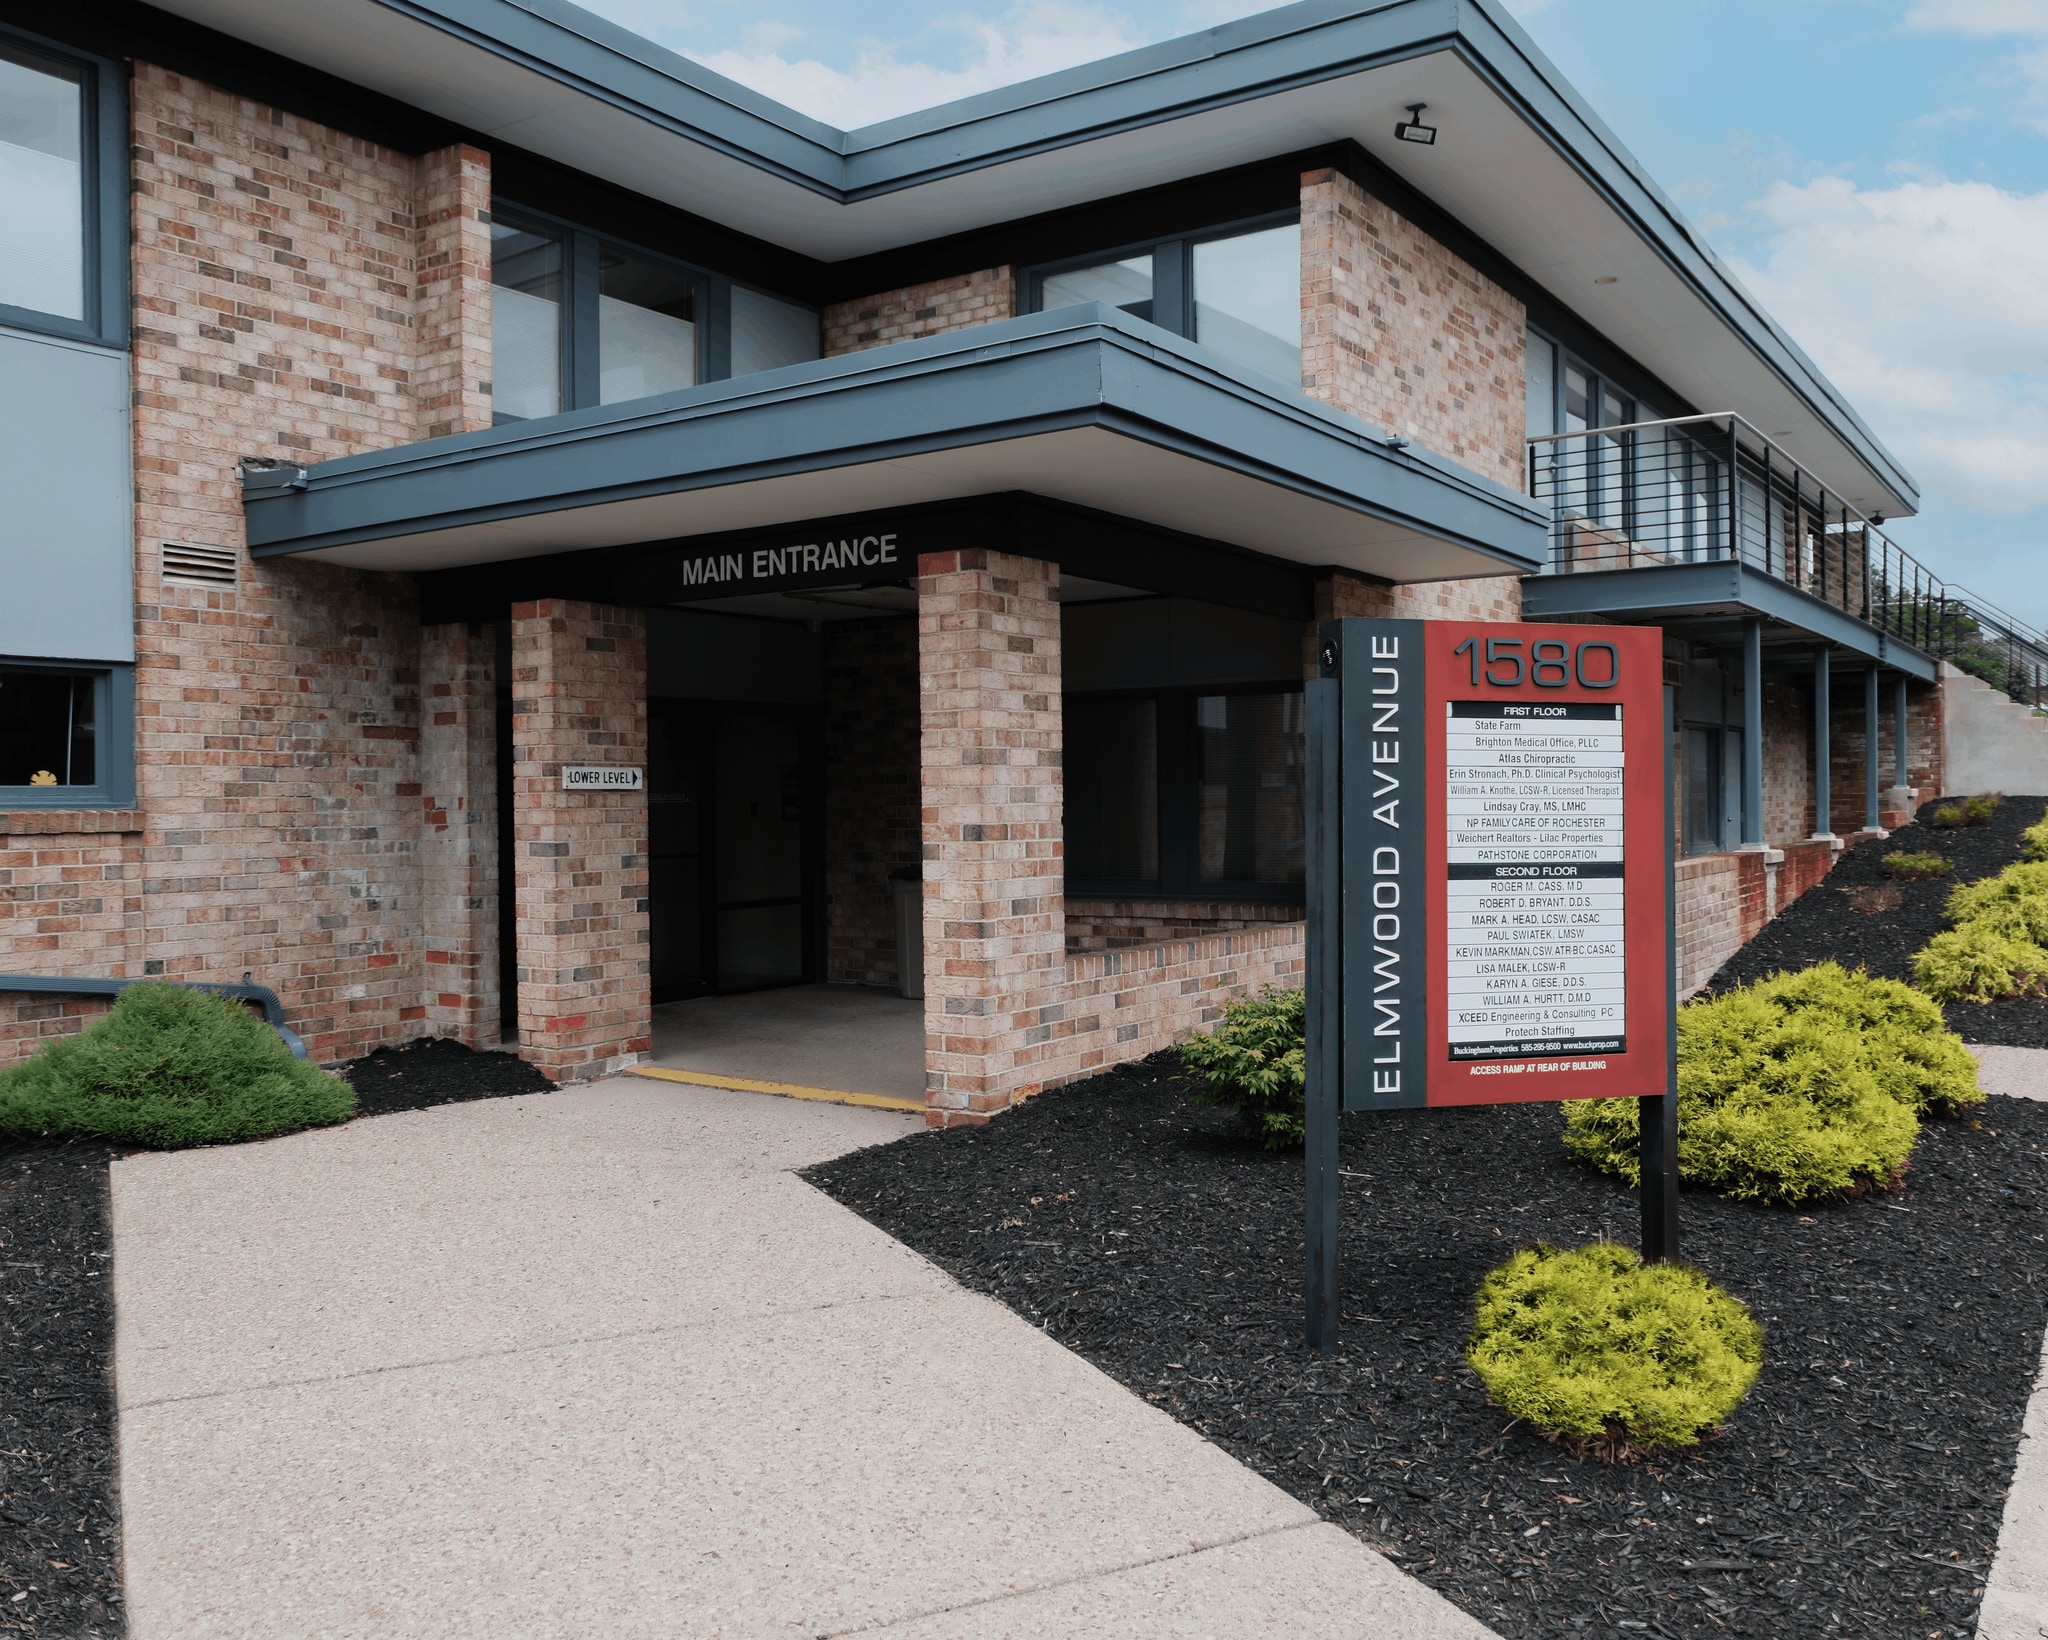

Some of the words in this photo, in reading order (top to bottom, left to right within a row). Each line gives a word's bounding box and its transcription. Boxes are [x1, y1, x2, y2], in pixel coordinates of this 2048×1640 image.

[683, 553, 743, 586] MAIN
[753, 534, 898, 578] ENTRANCE
[1455, 637, 1620, 688] 1580
[1504, 707, 1530, 716] FIRST
[1534, 707, 1567, 716] FLOOR
[1475, 721, 1496, 730] State
[1500, 721, 1521, 730] Farm
[1372, 636, 1400, 829] AVENUE
[1475, 737, 1512, 748] Brighton
[1515, 738, 1547, 747] Medical
[1550, 738, 1576, 748] Office,
[1578, 739, 1598, 747] PLLC
[1499, 754, 1521, 763] Atlas
[1524, 754, 1576, 765] Chiropractic
[569, 771, 600, 783] LOWER
[603, 772, 630, 784] LEVEL
[1450, 769, 1466, 778] Erin
[1469, 770, 1509, 779] Stronach,
[1512, 770, 1533, 778] Ph.D.
[1535, 769, 1566, 778] Clinical
[1569, 770, 1620, 780] Psychologist
[1451, 786, 1478, 795] William
[1481, 786, 1487, 795] A.
[1490, 786, 1517, 795] Knothe,
[1519, 786, 1550, 795] LCSW-R,
[1553, 786, 1583, 795] Licensed
[1586, 786, 1619, 797] Therapist
[1484, 802, 1517, 813] Lindsay
[1520, 802, 1541, 812] Cray,
[1544, 802, 1559, 812] MS,
[1562, 802, 1586, 811] LMHC
[1467, 819, 1478, 827] NP
[1538, 819, 1549, 827] OF
[1553, 819, 1605, 827] ROCHESTER
[1457, 834, 1494, 843] Weichert
[1497, 834, 1530, 843] Realtors
[1540, 834, 1559, 842] Lilac
[1562, 834, 1603, 844] Properties
[1478, 851, 1529, 859] PATHSTONE
[1533, 850, 1597, 859] CORPORATION
[1496, 868, 1539, 876] SECOND
[1543, 867, 1577, 875] FLOOR
[1491, 882, 1522, 891] ROGER
[1526, 882, 1535, 891] M.
[1480, 899, 1516, 908] ROBERT
[1519, 899, 1526, 908] D.
[1569, 897, 1592, 907] D.D.S.
[1472, 915, 1498, 924] MARK
[1501, 915, 1509, 924] A.
[1571, 913, 1599, 923] CASAC
[1487, 931, 1509, 940] PAUL
[1558, 929, 1585, 938] LMSW
[1456, 948, 1483, 957] KEVIN
[1372, 846, 1401, 1094] ELMWOOD
[1477, 964, 1496, 973] LISA
[1533, 962, 1566, 972] LCSW-R
[1487, 979, 1518, 989] KARYN
[1521, 979, 1529, 988] A.
[1563, 977, 1586, 986] D.D.S.
[1483, 995, 1520, 1005] WILLIAM
[1523, 995, 1531, 1004] A.
[1459, 1013, 1488, 1022] XCEED
[1491, 1011, 1541, 1023] Engineering
[1543, 1010, 1549, 1019] &
[1552, 1009, 1596, 1019] Consulting
[1601, 1008, 1613, 1017] PC
[1505, 1027, 1538, 1037] Protech
[1542, 1026, 1575, 1036] Staffing
[1563, 1041, 1619, 1050] www.buckprop.com
[1470, 1065, 1501, 1075] ACCESS
[1503, 1065, 1525, 1073] RAMP
[1527, 1064, 1535, 1072] AT
[1537, 1063, 1558, 1072] REAR
[1560, 1063, 1571, 1071] OF
[1572, 1061, 1606, 1070] BUILDING
